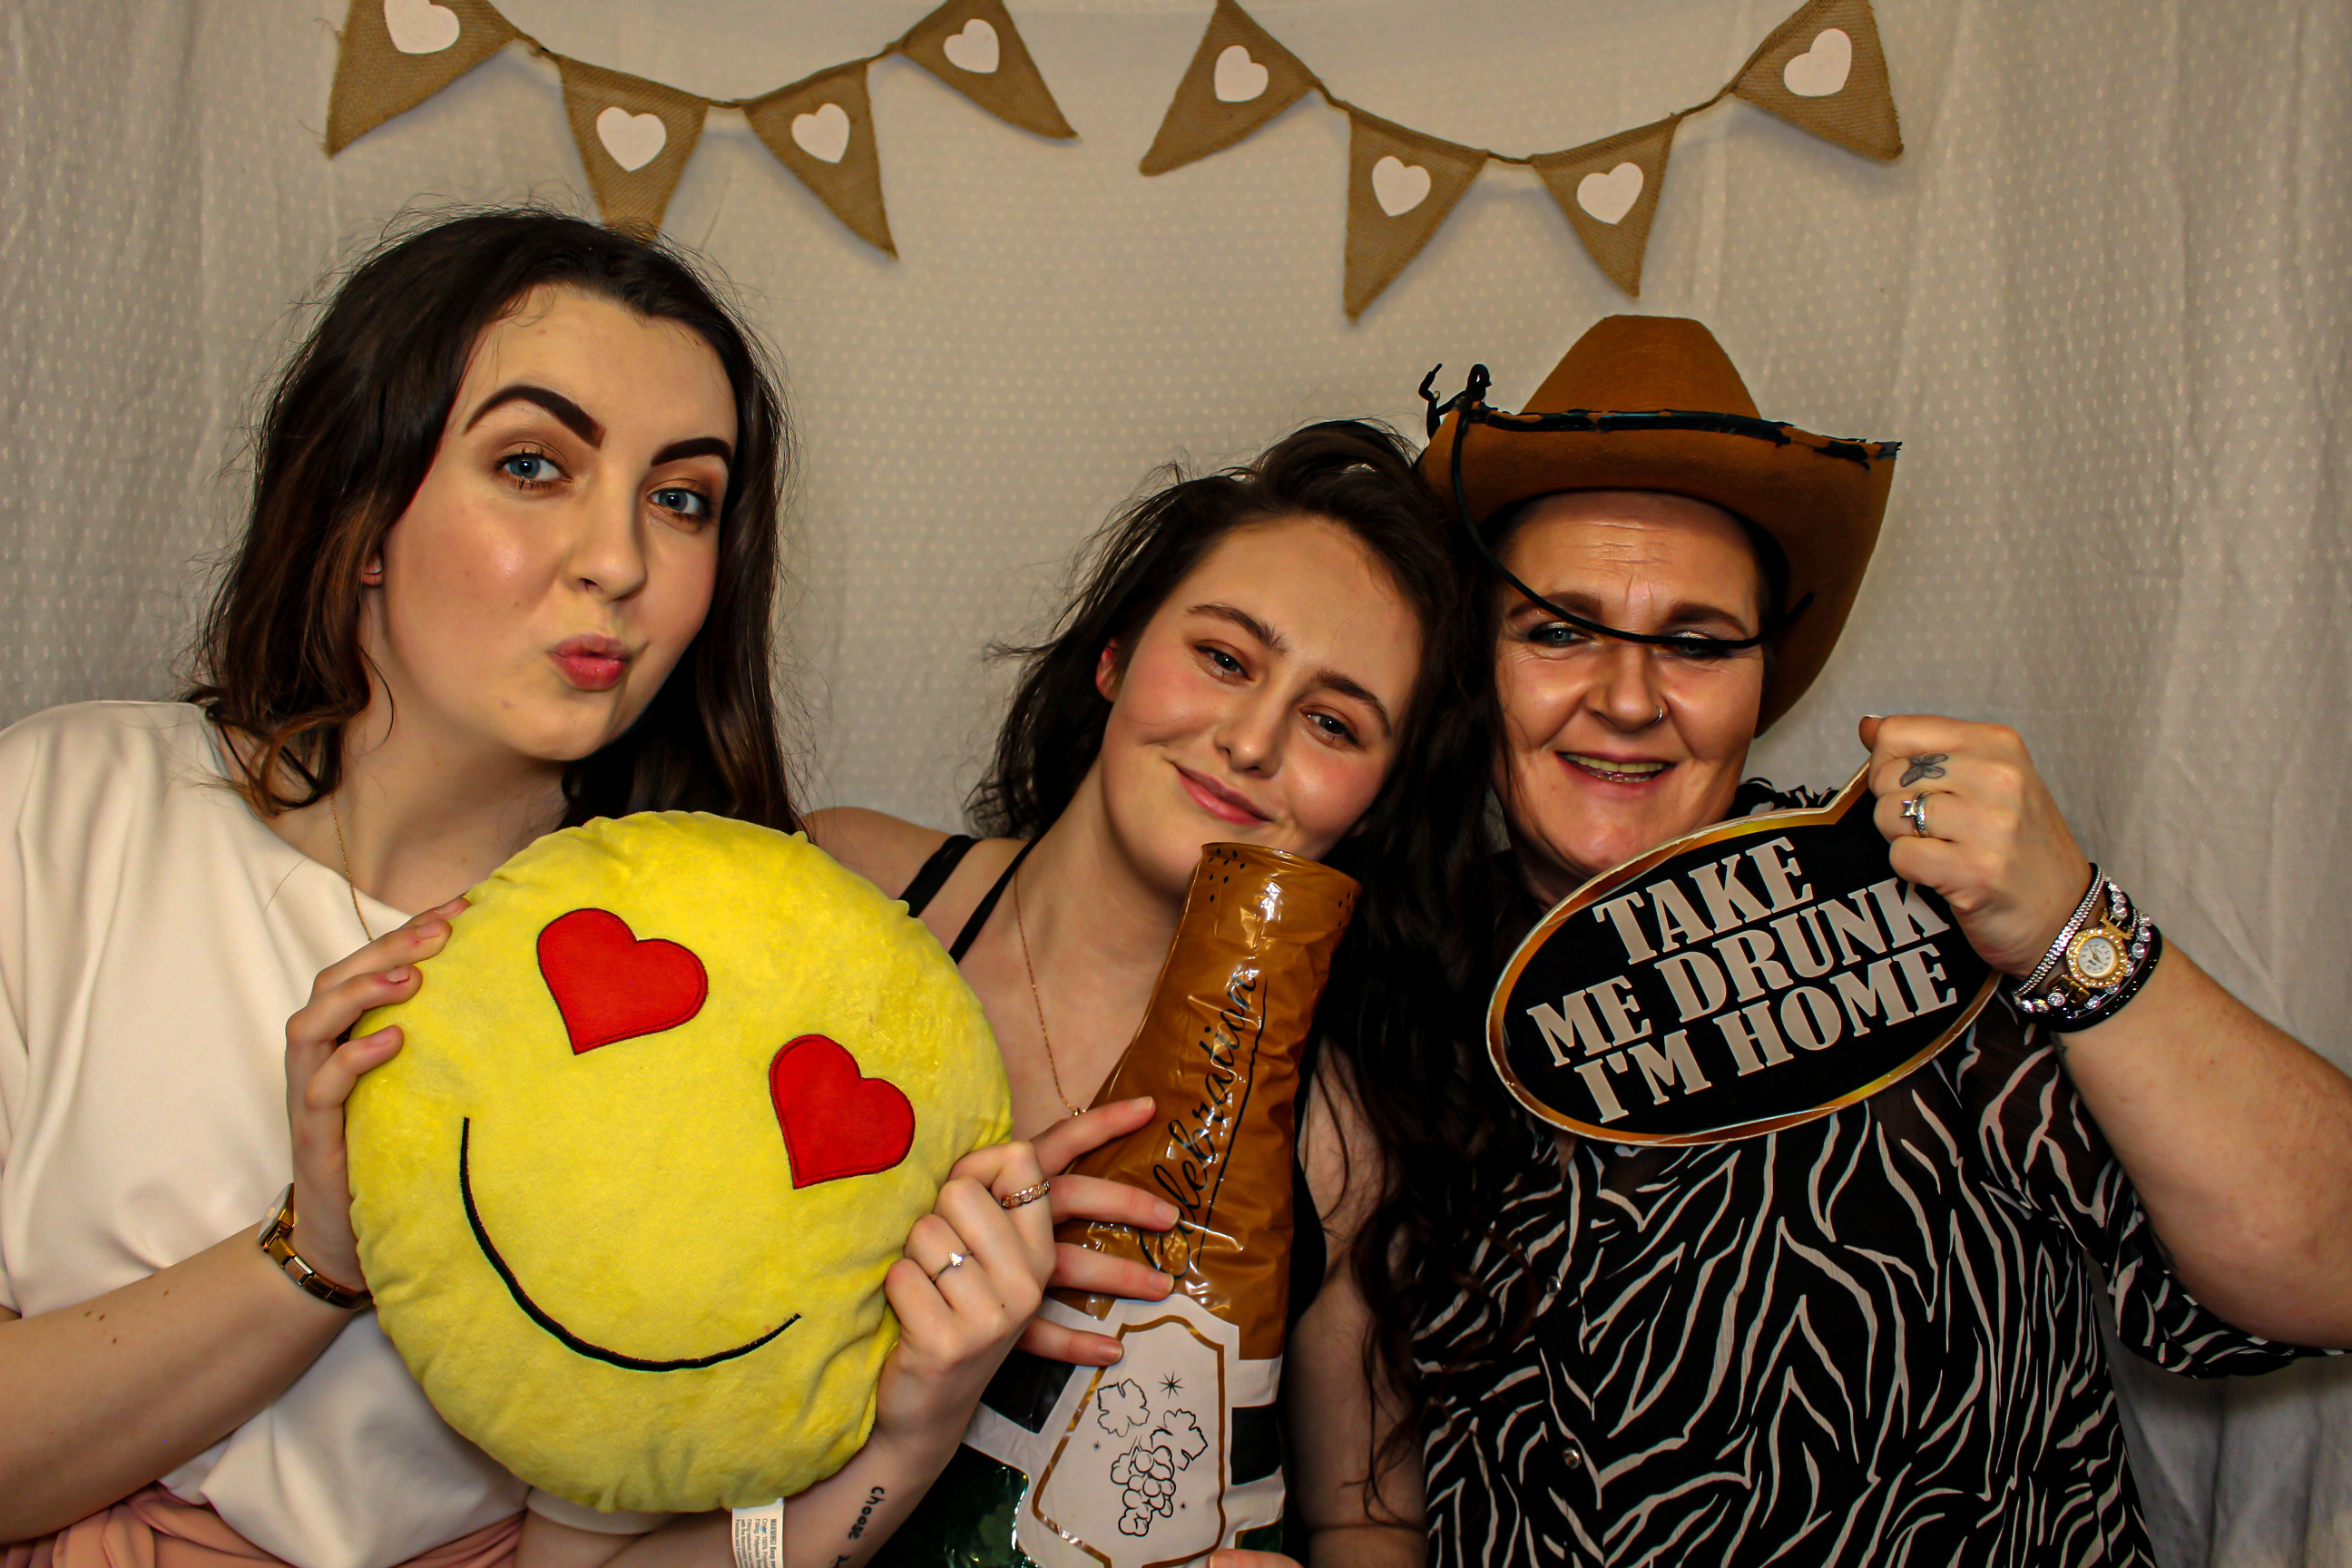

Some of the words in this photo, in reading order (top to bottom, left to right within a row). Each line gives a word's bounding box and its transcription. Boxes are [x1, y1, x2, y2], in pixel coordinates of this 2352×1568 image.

[1526, 975, 1651, 1066] ME
[1654, 877, 1950, 1023] DRUNK
[1592, 837, 1813, 965] TAKE
[1138, 967, 1258, 1280] Celebration
[1574, 1029, 1711, 1123] I'M
[1712, 944, 1956, 1076] HOME
